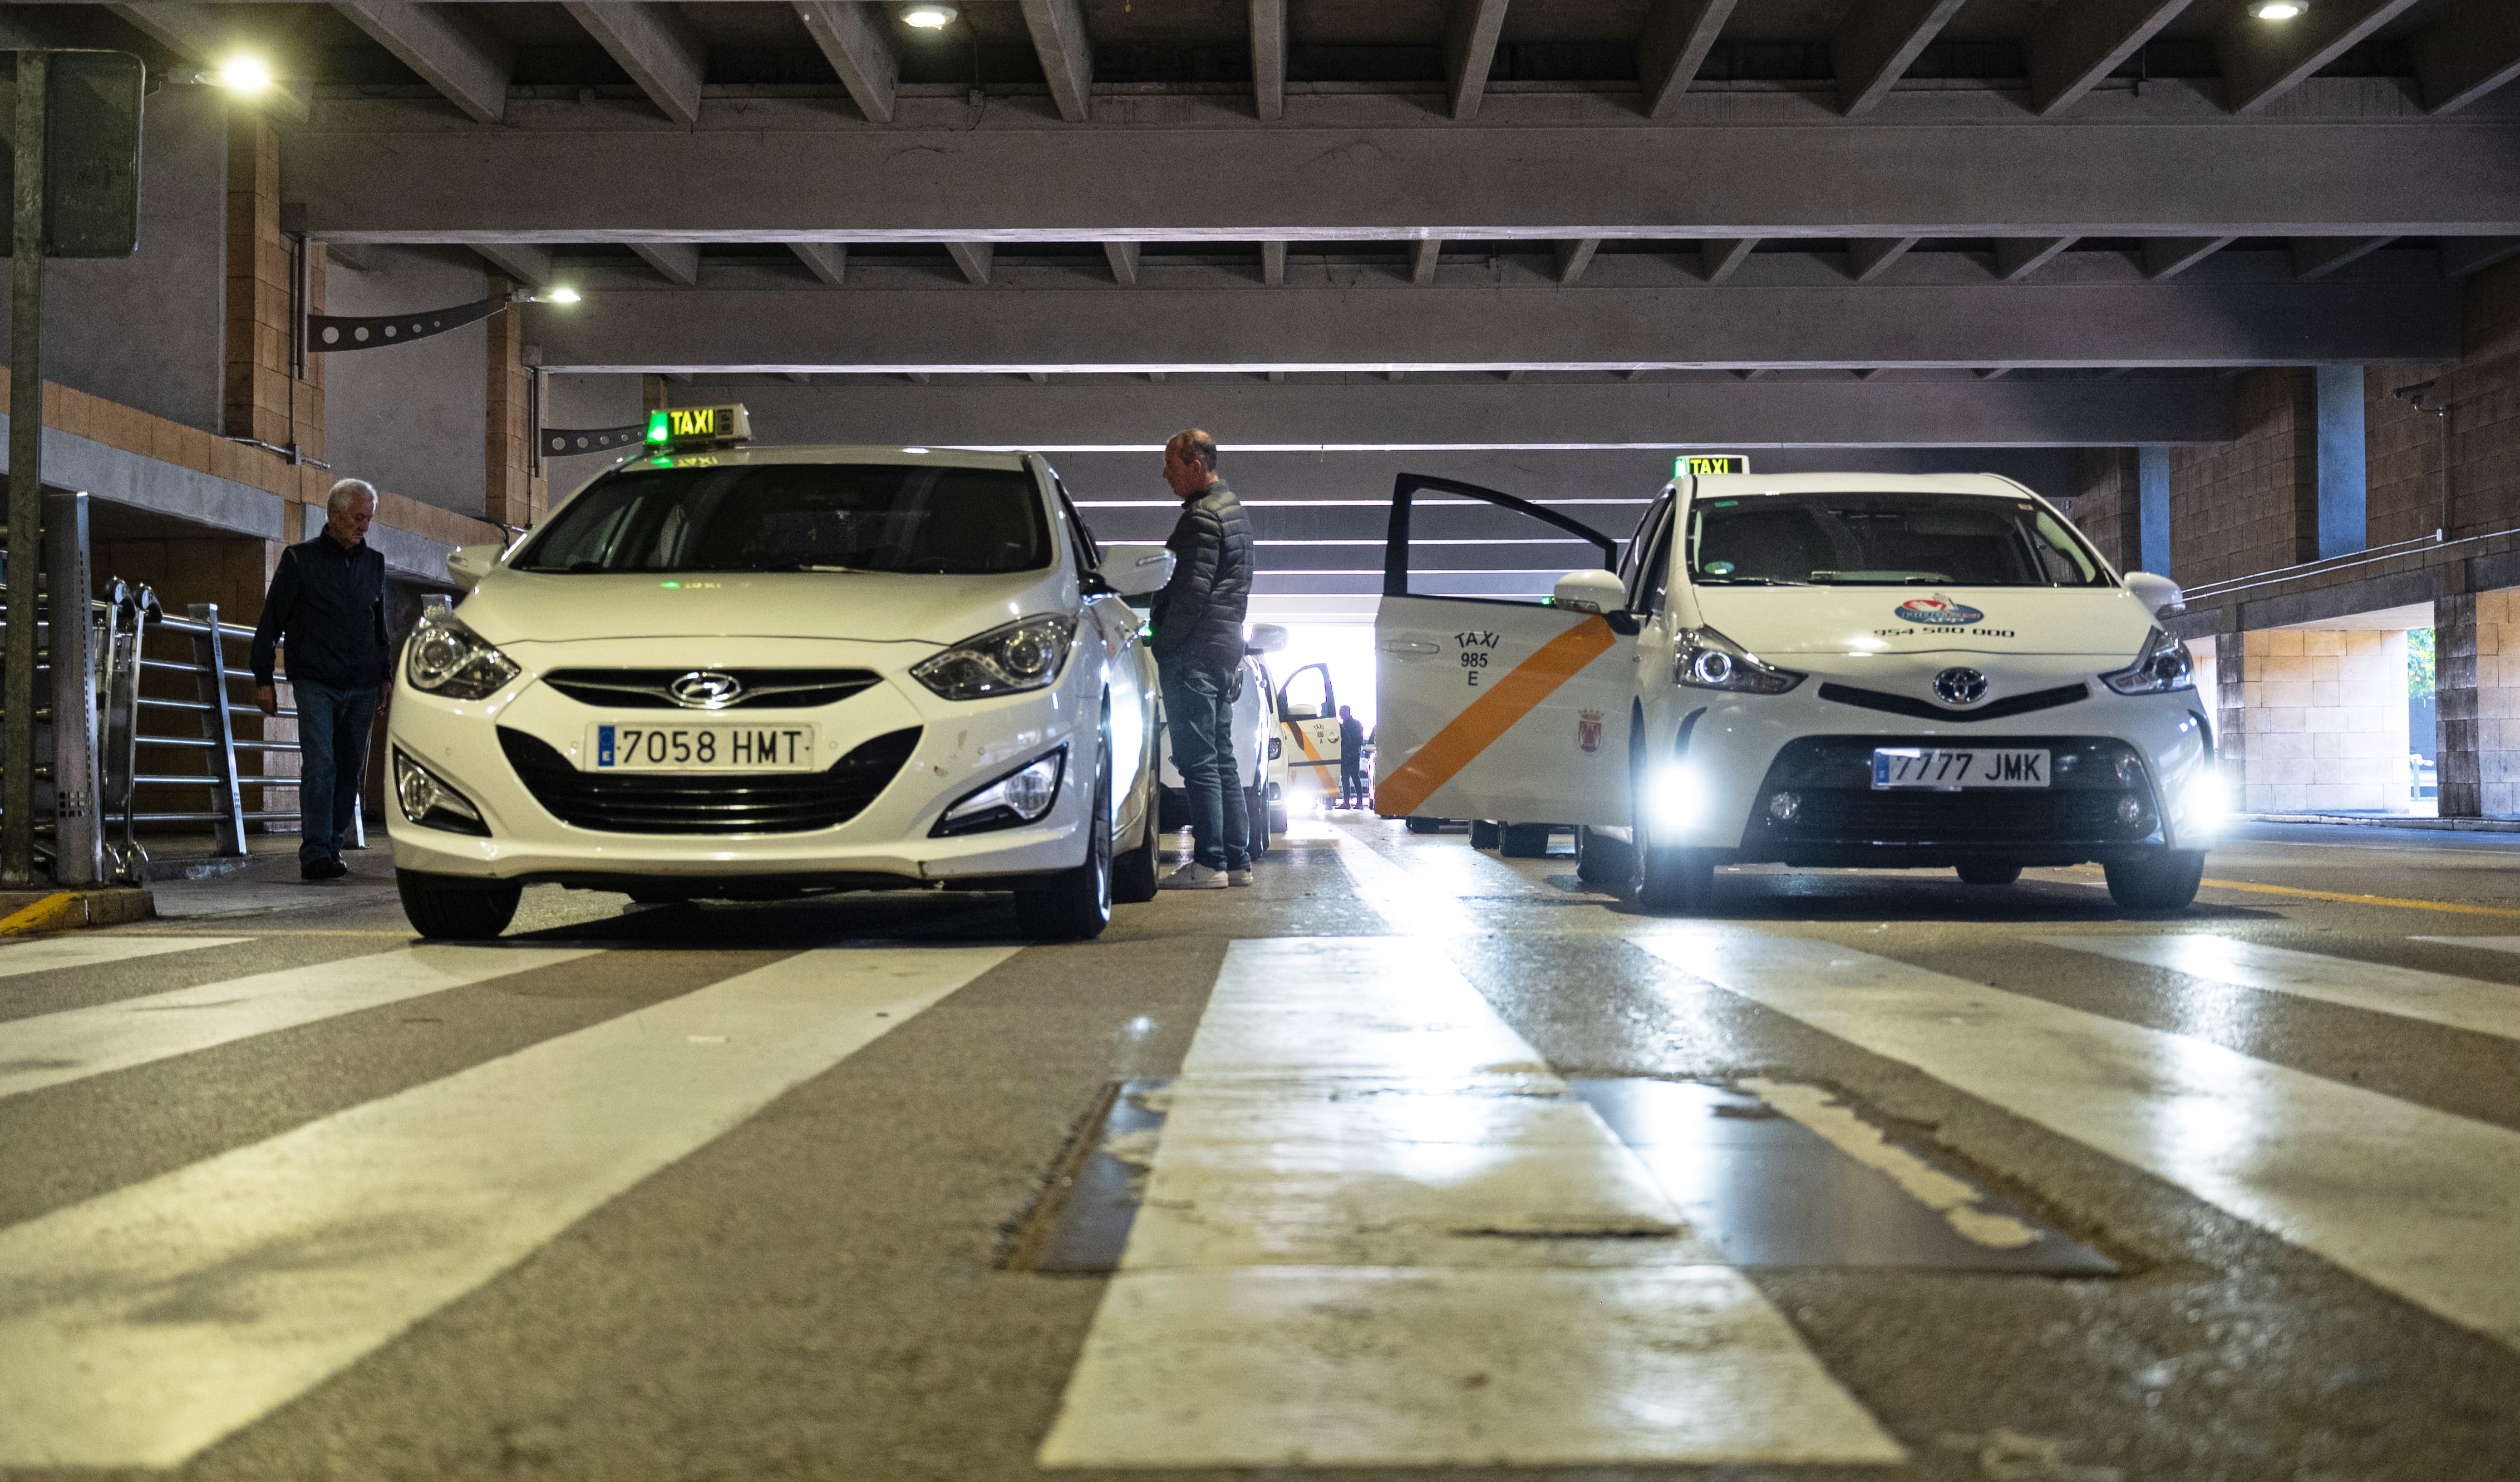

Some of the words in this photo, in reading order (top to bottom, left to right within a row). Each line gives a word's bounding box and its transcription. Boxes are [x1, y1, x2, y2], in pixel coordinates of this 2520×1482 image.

[670, 409, 714, 435] TAXI
[1690, 459, 1729, 475] TAXI
[1454, 631, 1500, 649] TAXI
[1973, 628, 2015, 637] 000
[1461, 652, 1488, 668] 985
[1468, 671, 1479, 686] E
[602, 751, 611, 762] E
[623, 731, 716, 764] 7058
[733, 731, 801, 764] HMT
[1896, 753, 1973, 780] 7777
[1985, 753, 2041, 781] JMK
